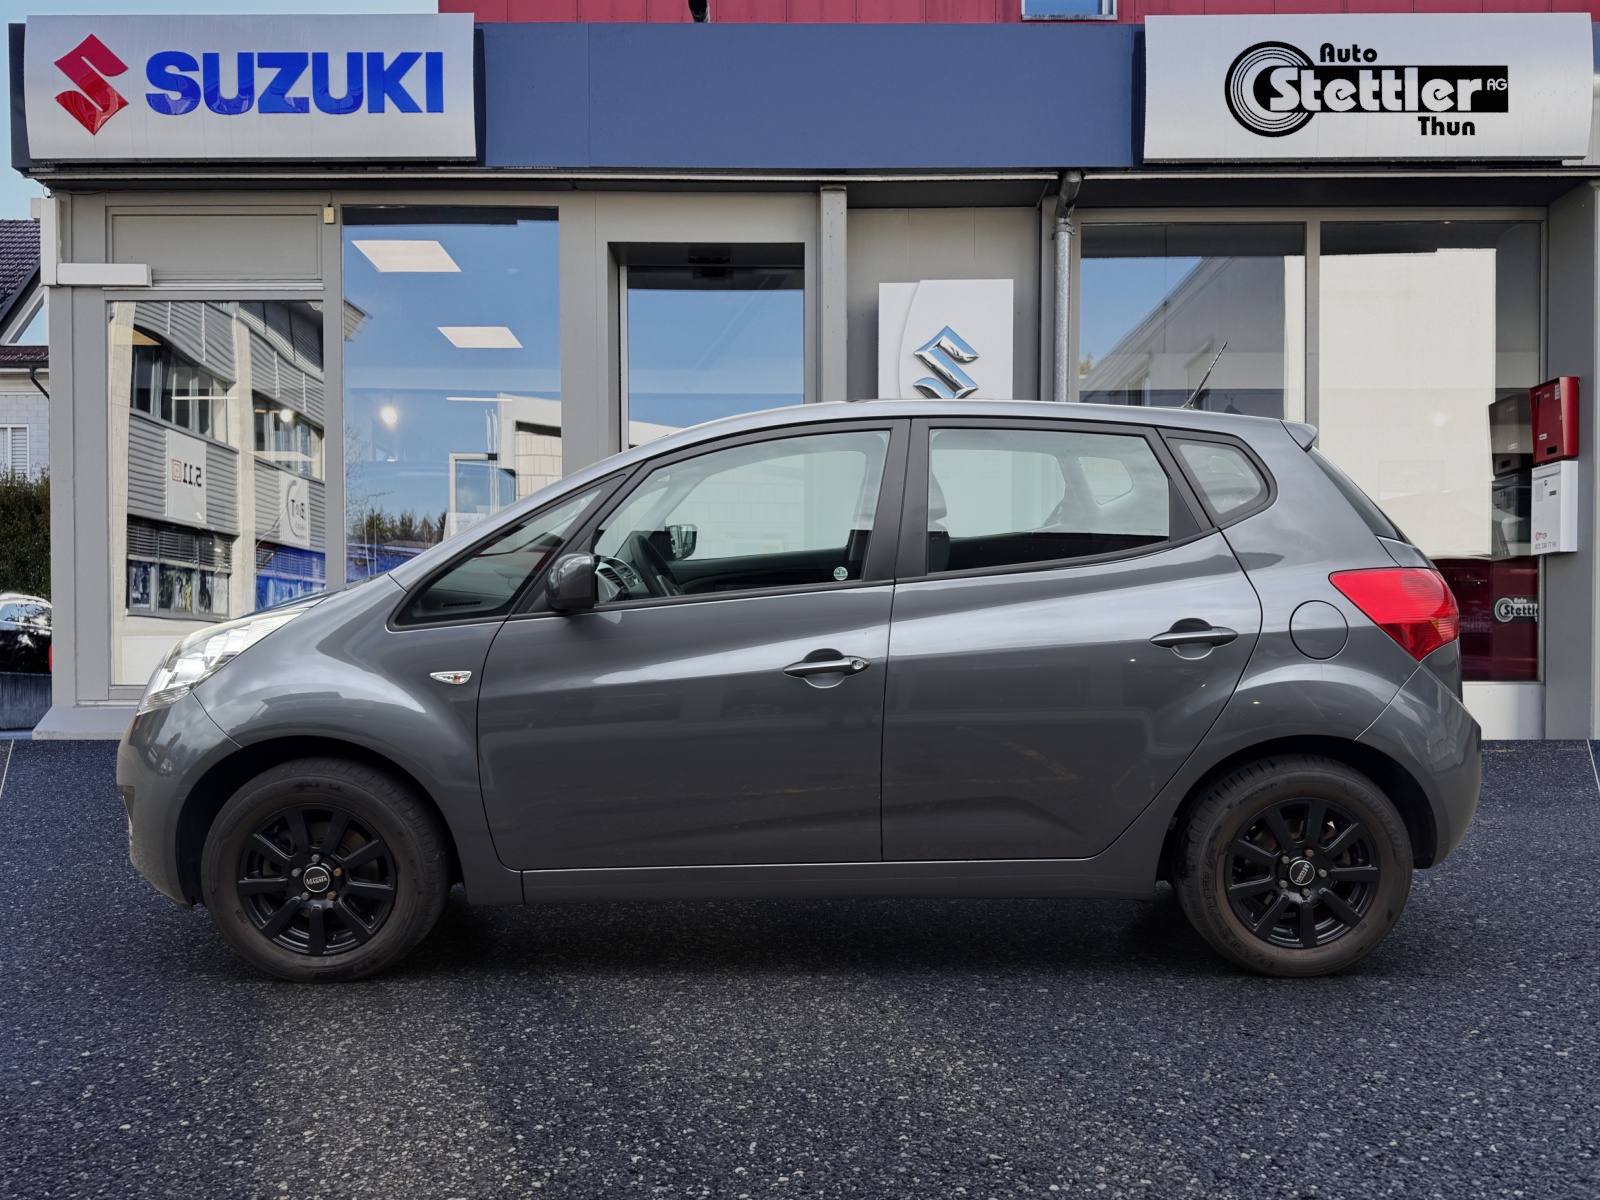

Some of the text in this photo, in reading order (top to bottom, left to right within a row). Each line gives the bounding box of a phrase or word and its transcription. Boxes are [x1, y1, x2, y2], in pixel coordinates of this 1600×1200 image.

[1319, 42, 1378, 63] Auto
[145, 50, 444, 116] SUZUKI
[1269, 66, 1508, 112] Stettler AG
[1417, 116, 1476, 136] Thun
[1504, 604, 1538, 616] Stettl
